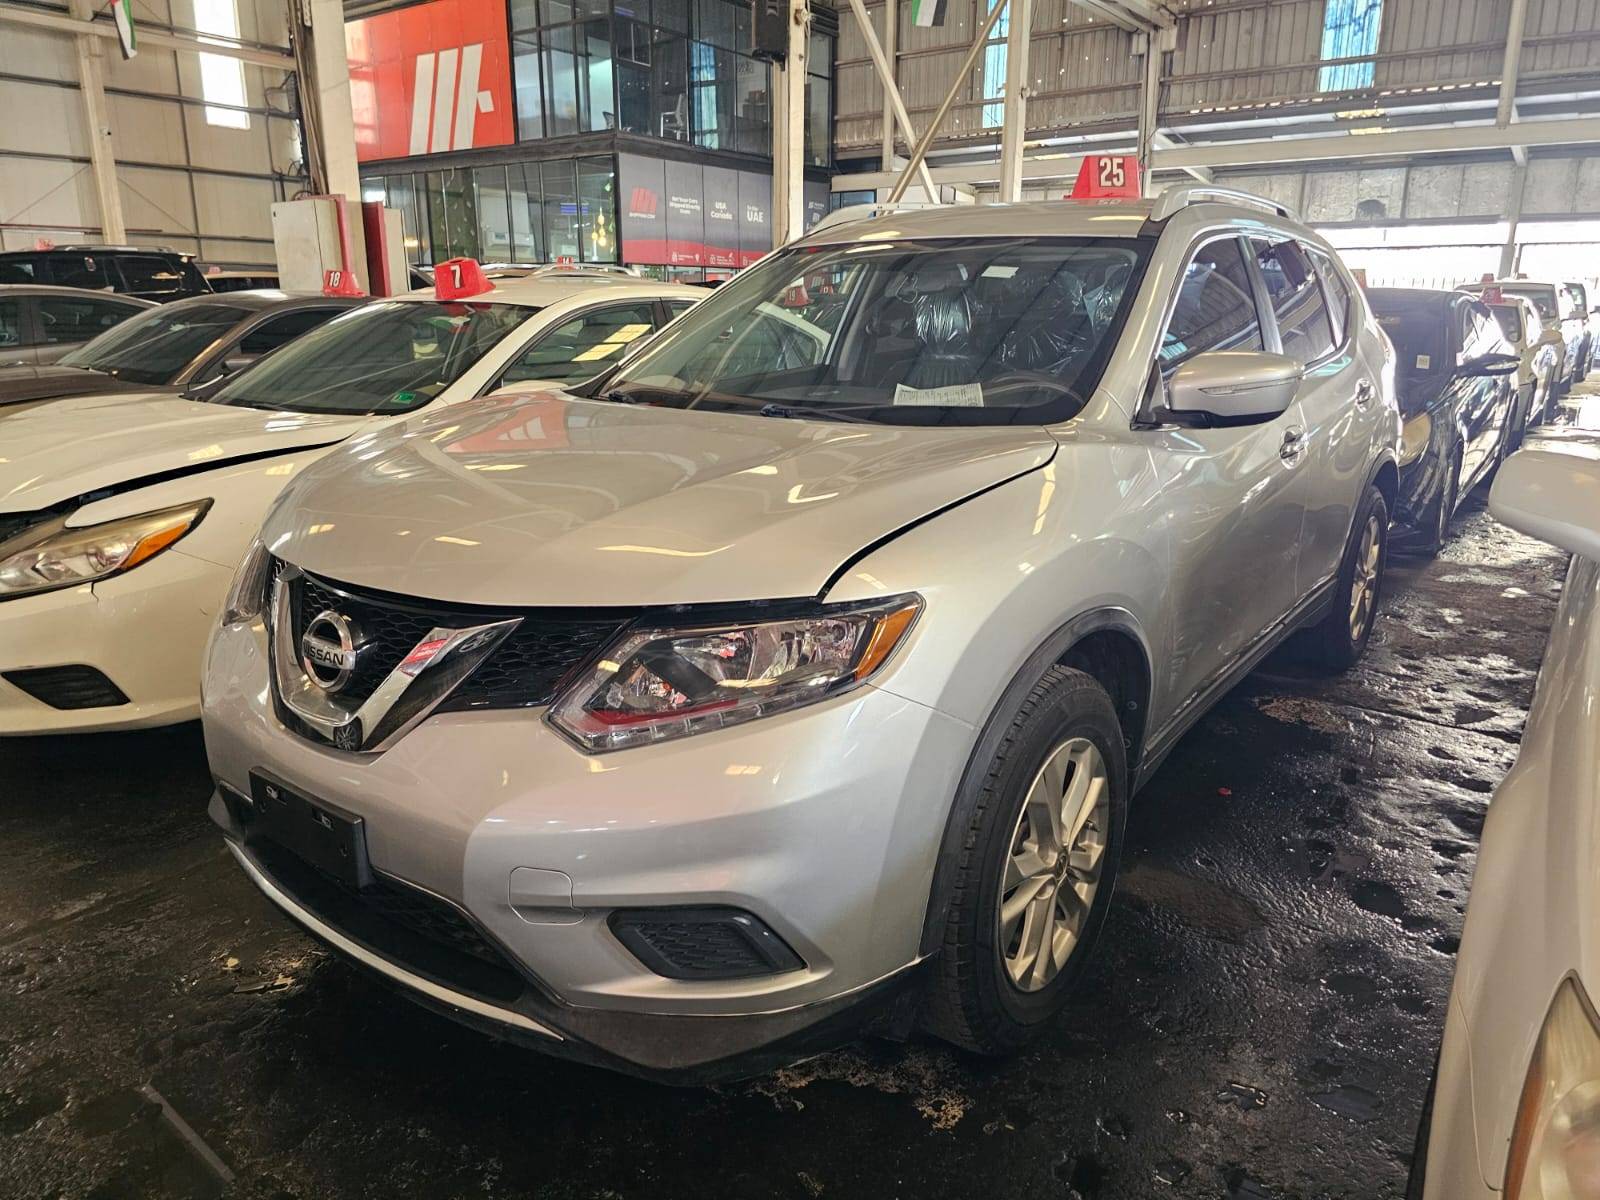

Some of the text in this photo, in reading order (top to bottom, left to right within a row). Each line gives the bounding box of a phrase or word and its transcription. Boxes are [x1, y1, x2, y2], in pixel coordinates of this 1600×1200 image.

[1099, 157, 1124, 187] 25
[715, 201, 727, 210] USA
[710, 210, 733, 220] Canada
[746, 211, 764, 223] UAE
[329, 271, 341, 287] 18
[451, 265, 462, 289] 7
[303, 639, 344, 665] NISSAN
